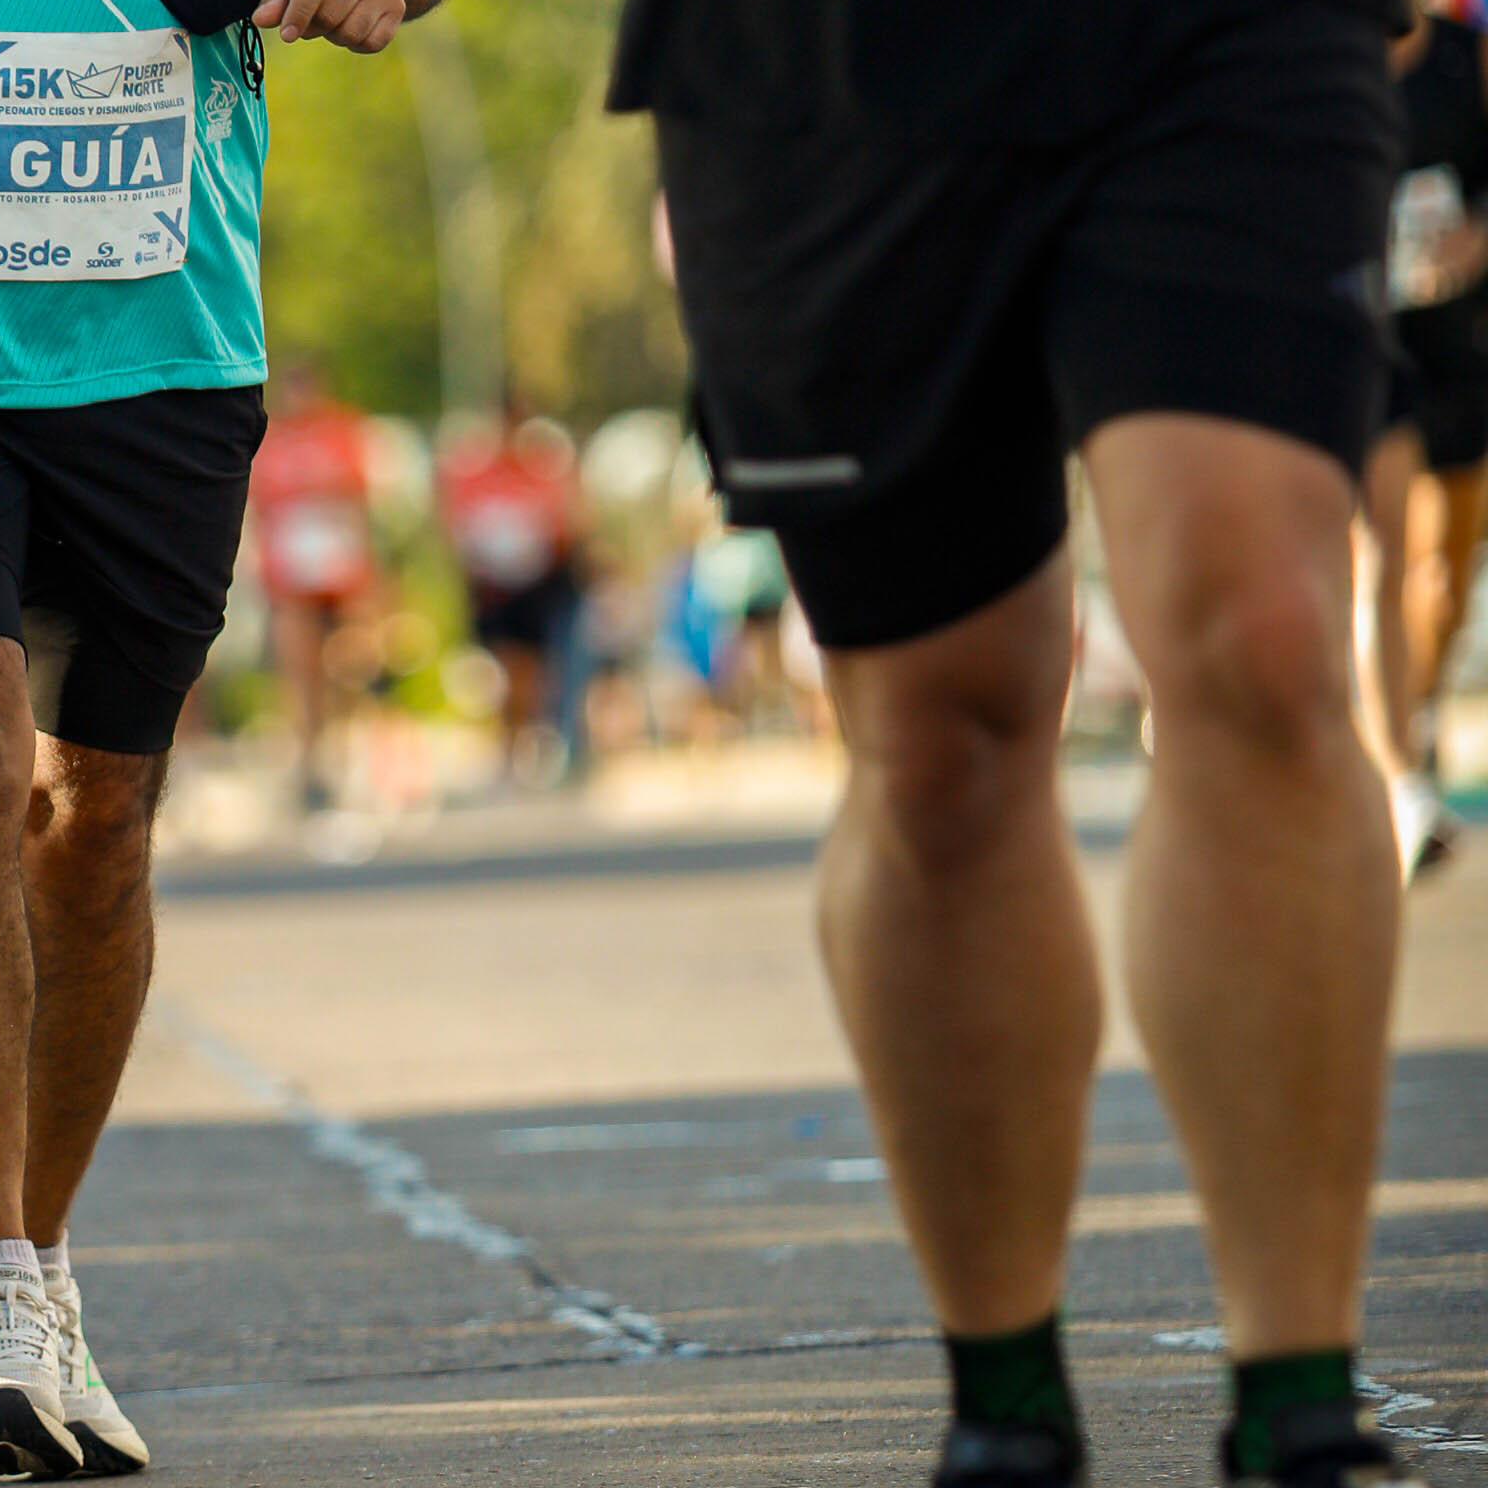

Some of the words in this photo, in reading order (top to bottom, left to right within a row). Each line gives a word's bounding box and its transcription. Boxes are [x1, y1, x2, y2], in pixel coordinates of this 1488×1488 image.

[123, 61, 173, 82] PUERTO
[122, 78, 165, 98] NORTE
[48, 106, 85, 116] CIEGOS
[87, 106, 95, 116] Y
[152, 96, 185, 111] VISUALES
[9, 124, 164, 188] GUÍA
[16, 194, 51, 204] NORTE
[63, 194, 106, 204] ROSARIO
[118, 193, 129, 202] 12
[132, 192, 143, 201] DE
